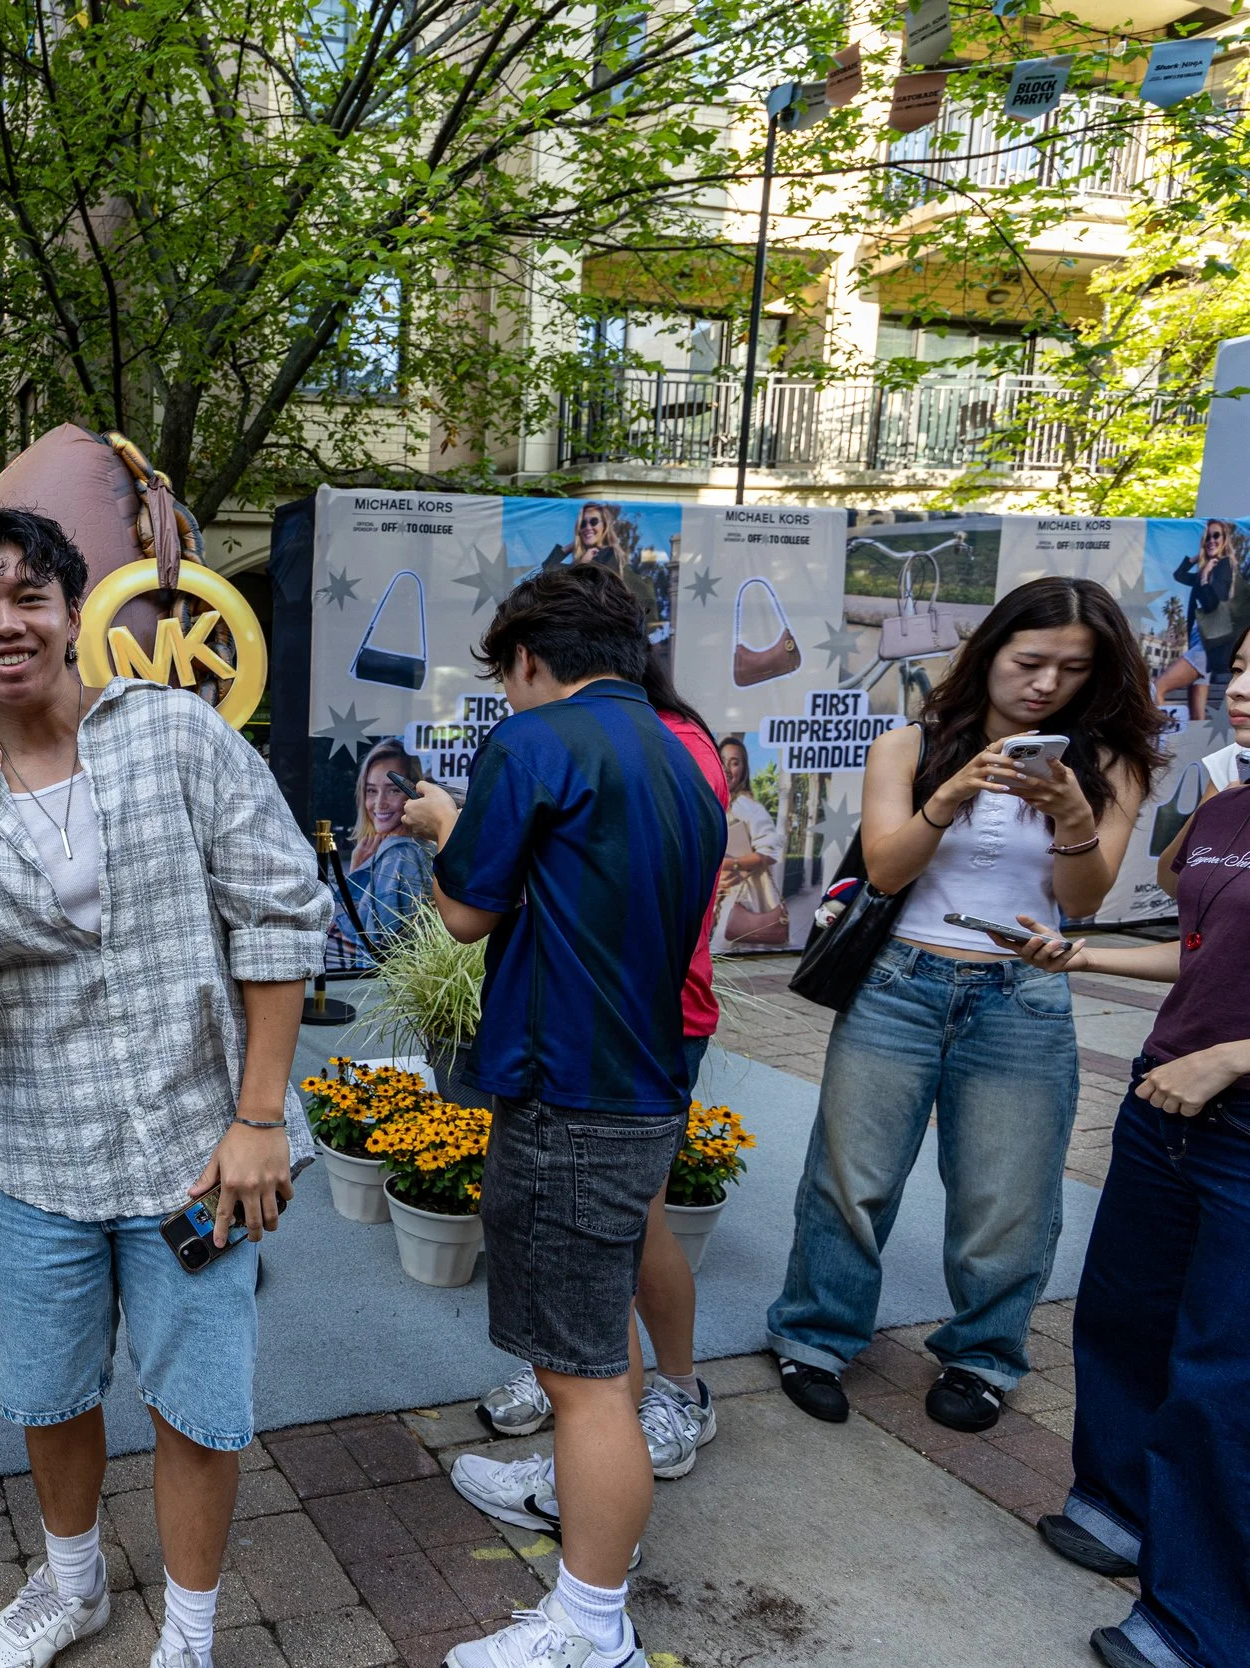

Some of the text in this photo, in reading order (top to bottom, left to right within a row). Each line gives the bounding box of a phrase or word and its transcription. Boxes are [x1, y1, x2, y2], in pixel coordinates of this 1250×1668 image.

[1154, 63, 1178, 71] Shark
[1016, 79, 1058, 94] BLOCK
[896, 90, 941, 103] GATORADE
[1012, 92, 1054, 106] PARTY
[354, 498, 453, 513] MICHAEL KORS
[725, 511, 810, 525] MICHAEL KORS
[381, 522, 453, 534] OFF TO COLLEGE
[1038, 520, 1111, 531] MICHAEL KORS
[747, 534, 810, 545] OFF TO COLLEGE
[1056, 541, 1070, 549] OFF
[1076, 541, 1084, 549] TO
[1085, 541, 1110, 549] COLLEGE
[107, 610, 237, 687] MK
[464, 697, 509, 721] FIRS
[811, 693, 861, 716] FIRST
[789, 745, 870, 768] HANDLE
